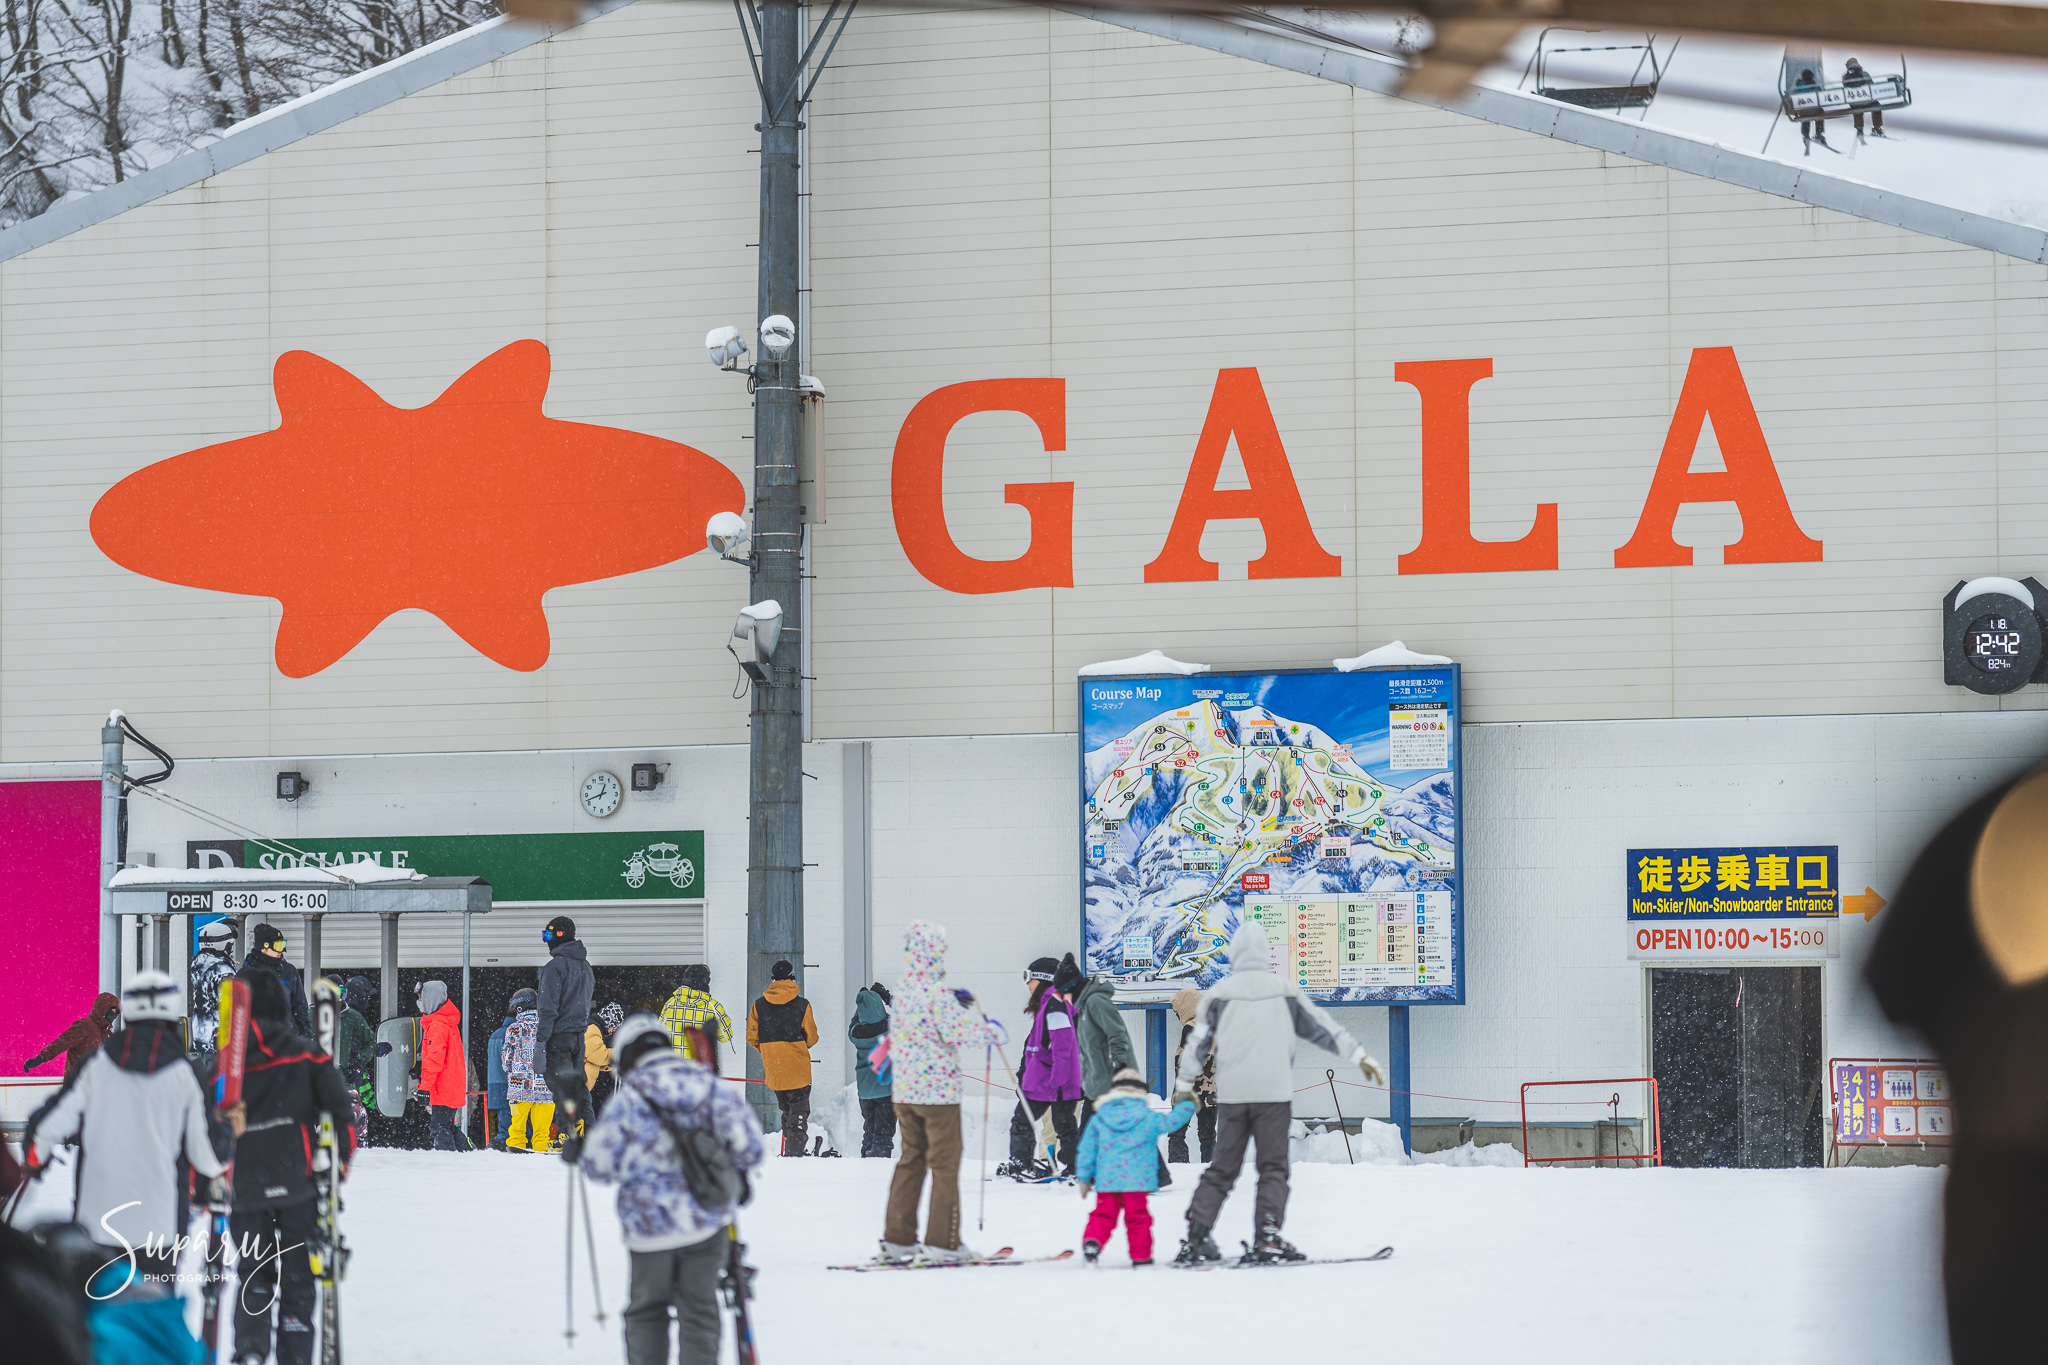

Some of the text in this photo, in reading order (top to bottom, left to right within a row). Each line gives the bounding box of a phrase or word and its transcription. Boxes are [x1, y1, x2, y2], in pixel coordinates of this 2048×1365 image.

[891, 346, 1824, 595] GALA
[1976, 632, 2020, 654] 12:42
[1092, 687, 1162, 701] Course Map
[1092, 702, 1124, 710] コースマップ
[1638, 854, 1828, 893] 徒歩乗車口
[169, 895, 211, 909] OPEN
[224, 894, 258, 908] 8:30
[281, 893, 327, 908] 16:00
[1632, 896, 1834, 915] Non-Skier/Non-Snowboarder Entrance
[1636, 928, 1691, 950] OPEN
[1842, 1071, 1851, 1135] リフト乗降方法
[1852, 1071, 1865, 1135] 4人乗り
